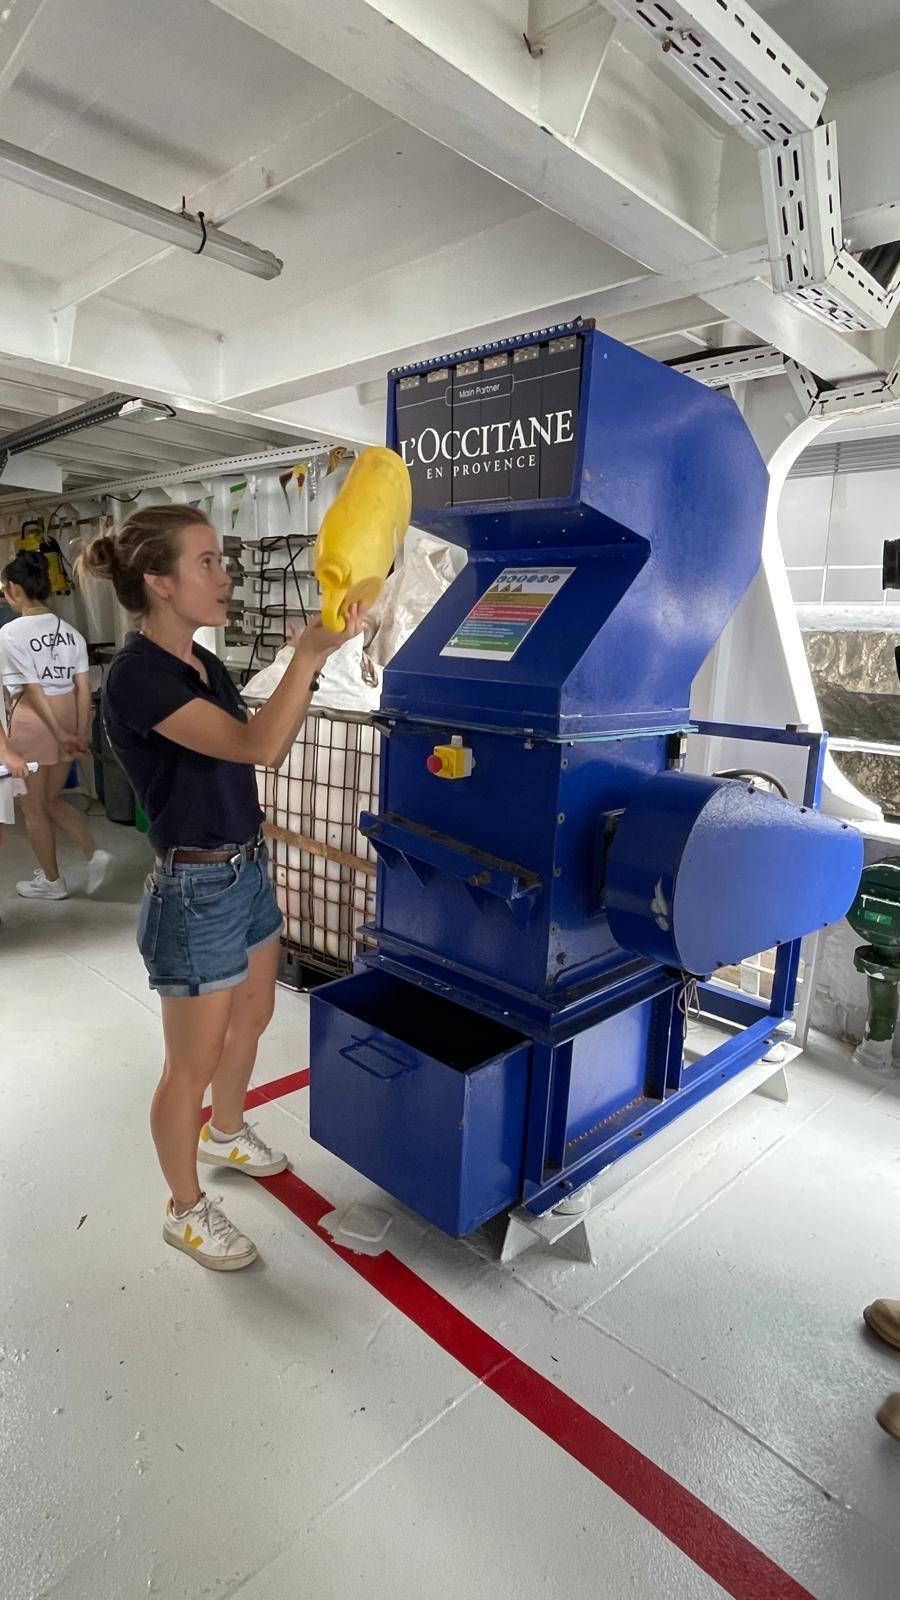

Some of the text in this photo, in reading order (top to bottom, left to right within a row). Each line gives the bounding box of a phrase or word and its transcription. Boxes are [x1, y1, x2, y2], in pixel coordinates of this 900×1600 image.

[459, 384, 500, 398] Main Partner
[400, 410, 574, 467] L'OCCITANE
[427, 454, 536, 479] EN PROVENCE
[30, 632, 75, 652] OCEAN
